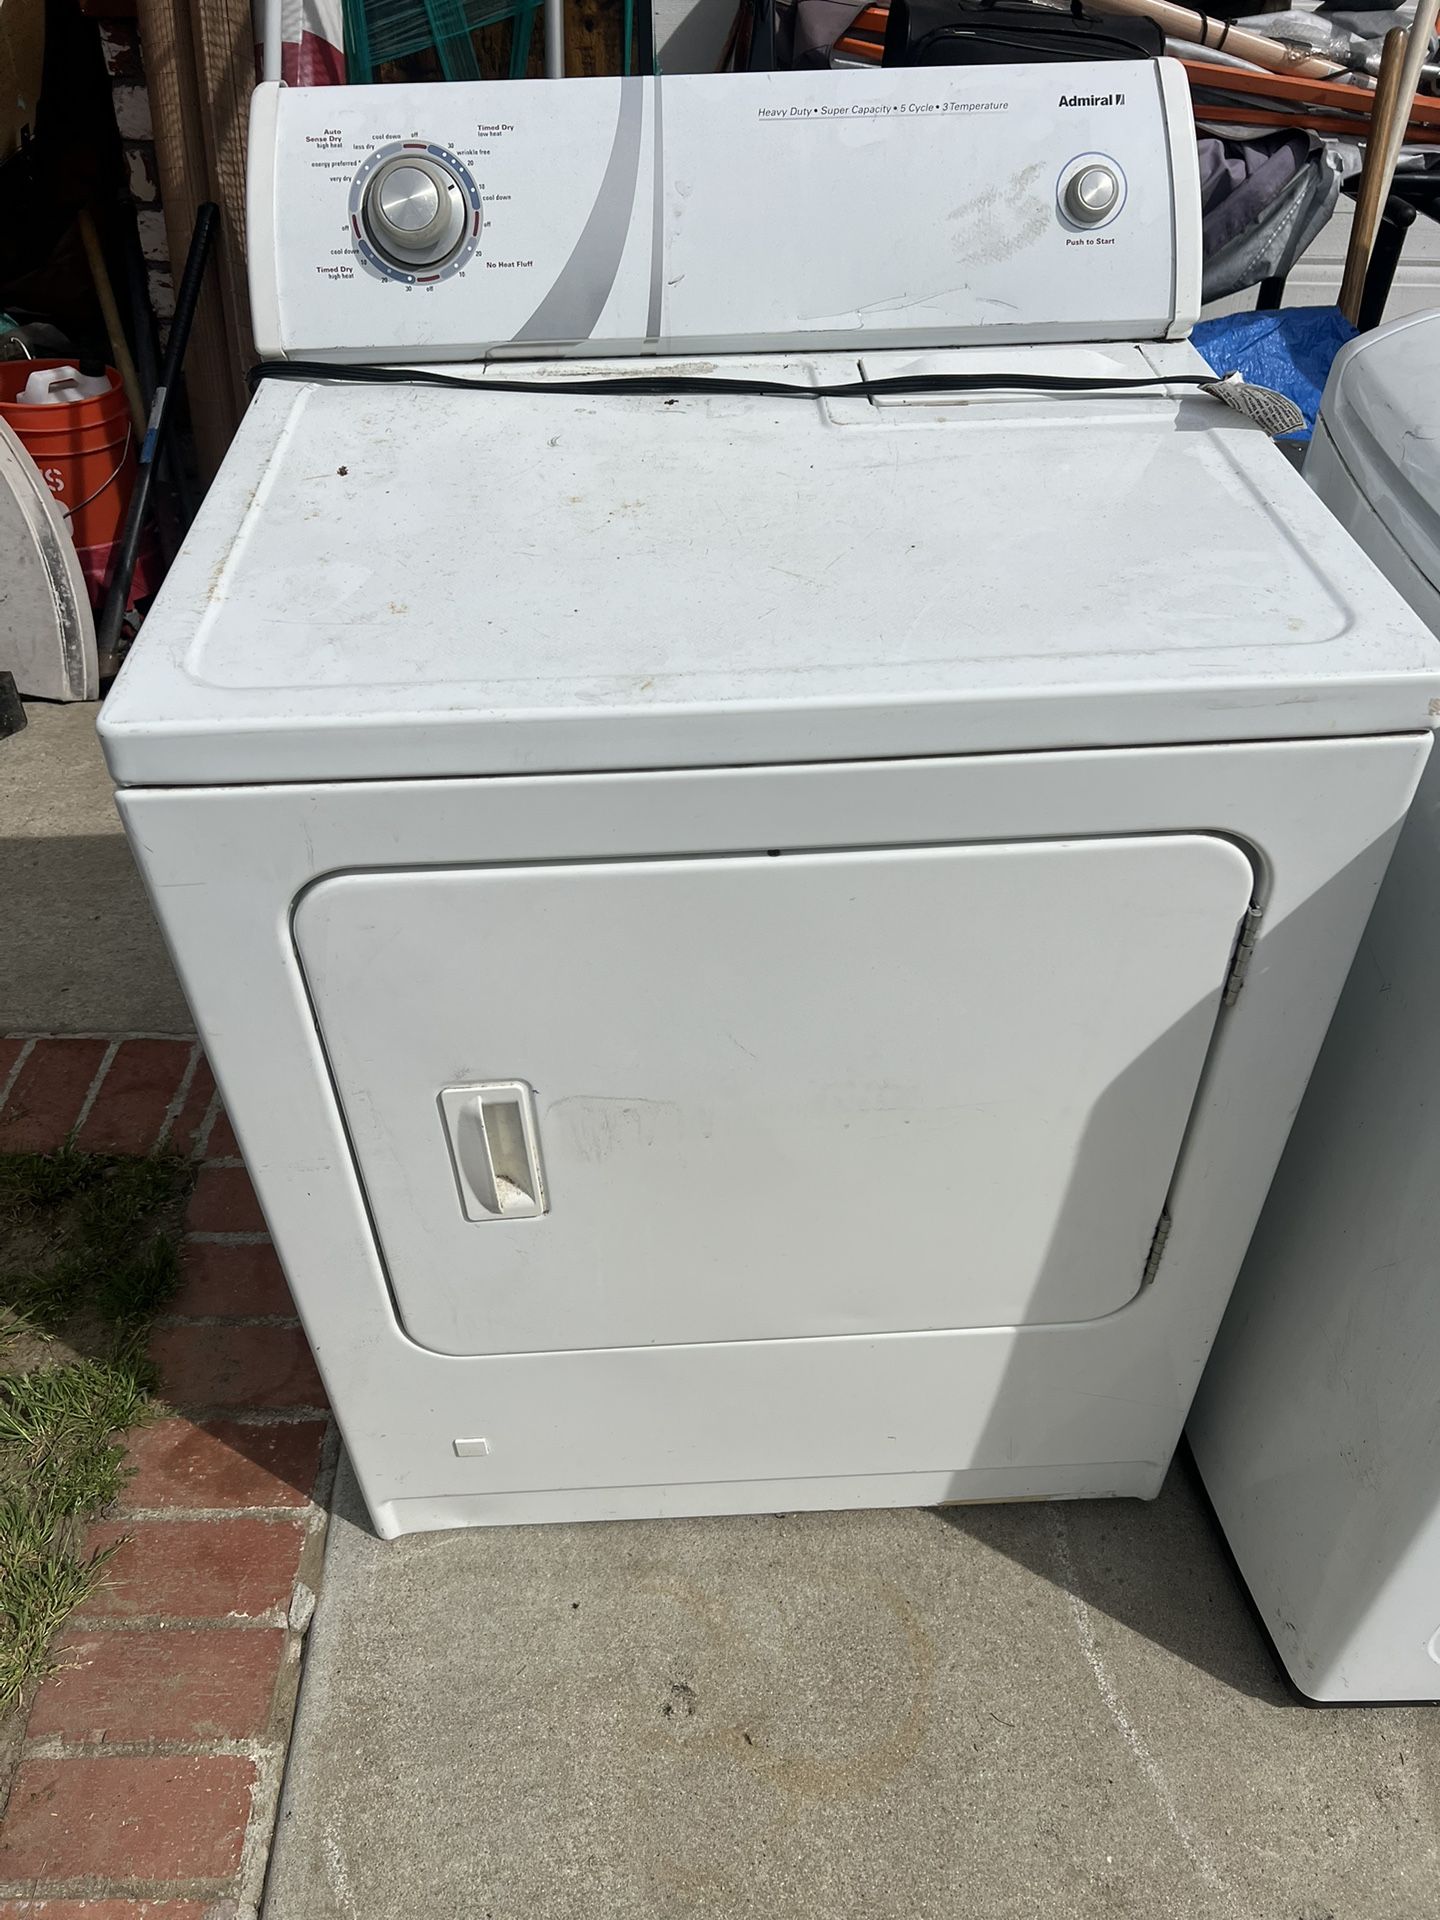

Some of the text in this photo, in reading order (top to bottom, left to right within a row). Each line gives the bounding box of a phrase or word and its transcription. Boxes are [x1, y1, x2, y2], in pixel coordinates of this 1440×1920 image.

[1059, 94, 1113, 107] Admiral
[758, 101, 1009, 117] Heavy Duty Super Capacity 5 Cycle 3 Temperature
[332, 160, 357, 168] preferred
